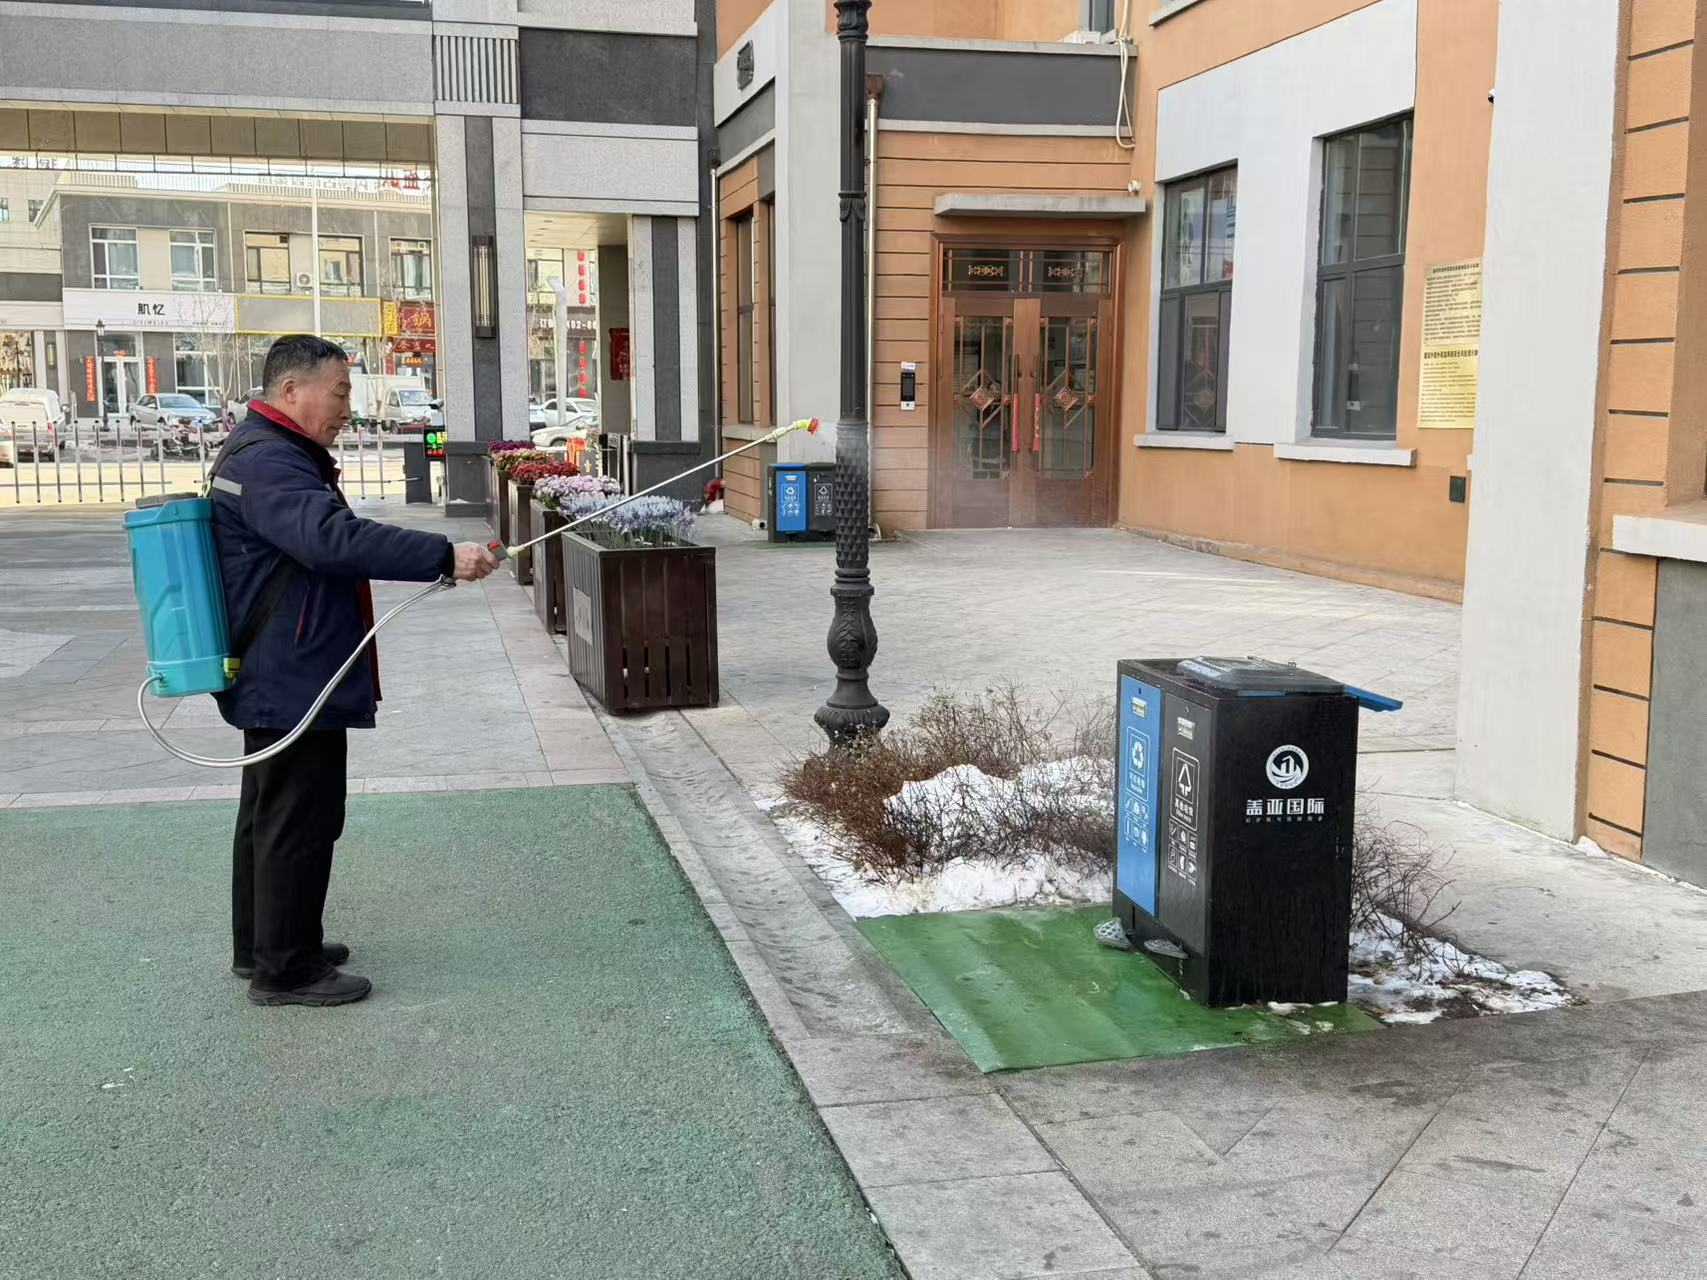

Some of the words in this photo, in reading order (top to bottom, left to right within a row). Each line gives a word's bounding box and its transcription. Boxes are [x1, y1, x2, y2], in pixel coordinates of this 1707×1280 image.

[137, 303, 166, 316] 肌忆
[1246, 797, 1325, 816] 盖亚国际
